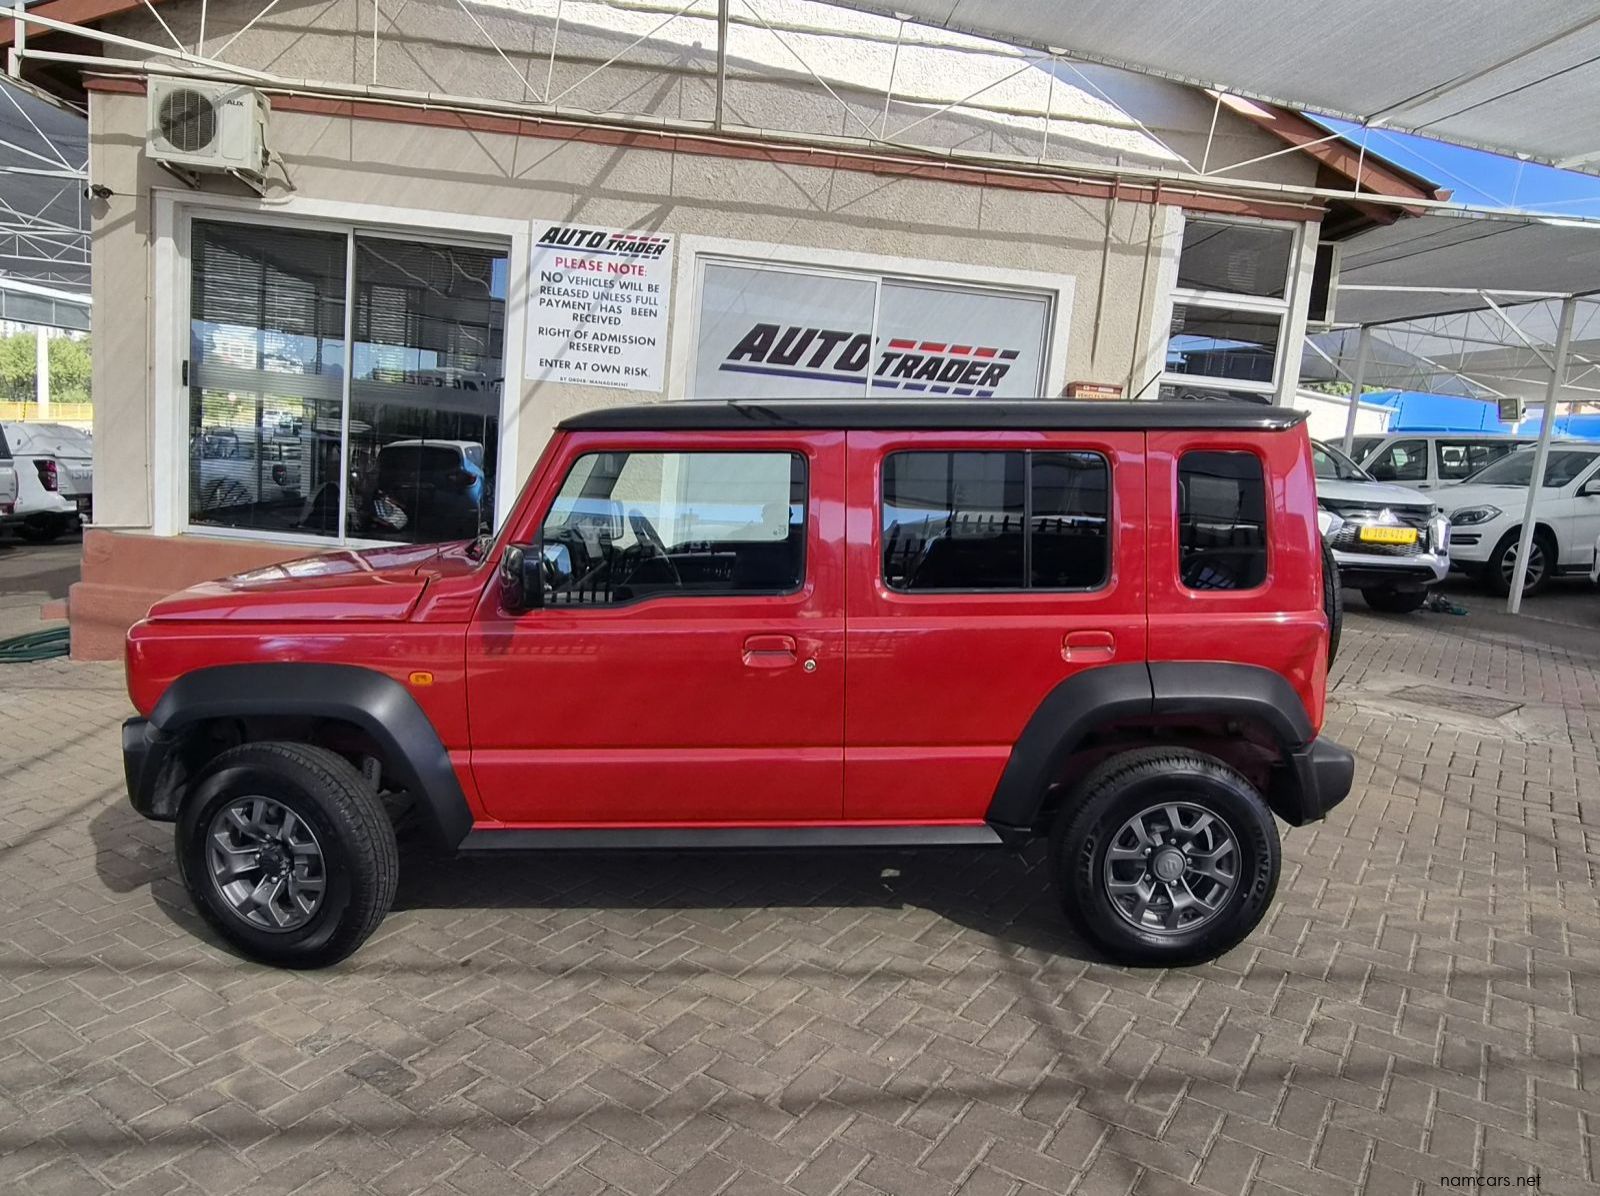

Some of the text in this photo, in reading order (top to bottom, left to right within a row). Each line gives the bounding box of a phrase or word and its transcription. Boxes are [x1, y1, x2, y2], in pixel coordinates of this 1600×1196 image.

[538, 226, 667, 256] AUTO TRADER
[555, 256, 603, 272] PLEASE
[540, 270, 660, 294] NO VEHICLES WILL BE
[540, 285, 659, 306] RELEASED UNLESS FULL
[539, 297, 658, 318] PAYMENT HAS BEEN
[538, 326, 656, 346] RIGHT OF ADMISSION
[726, 322, 1011, 388] AUTO TRADER
[539, 358, 571, 369] ENTER
[574, 361, 588, 371] AT
[591, 363, 621, 375] OWN
[589, 379, 629, 387] MANAGEMENT
